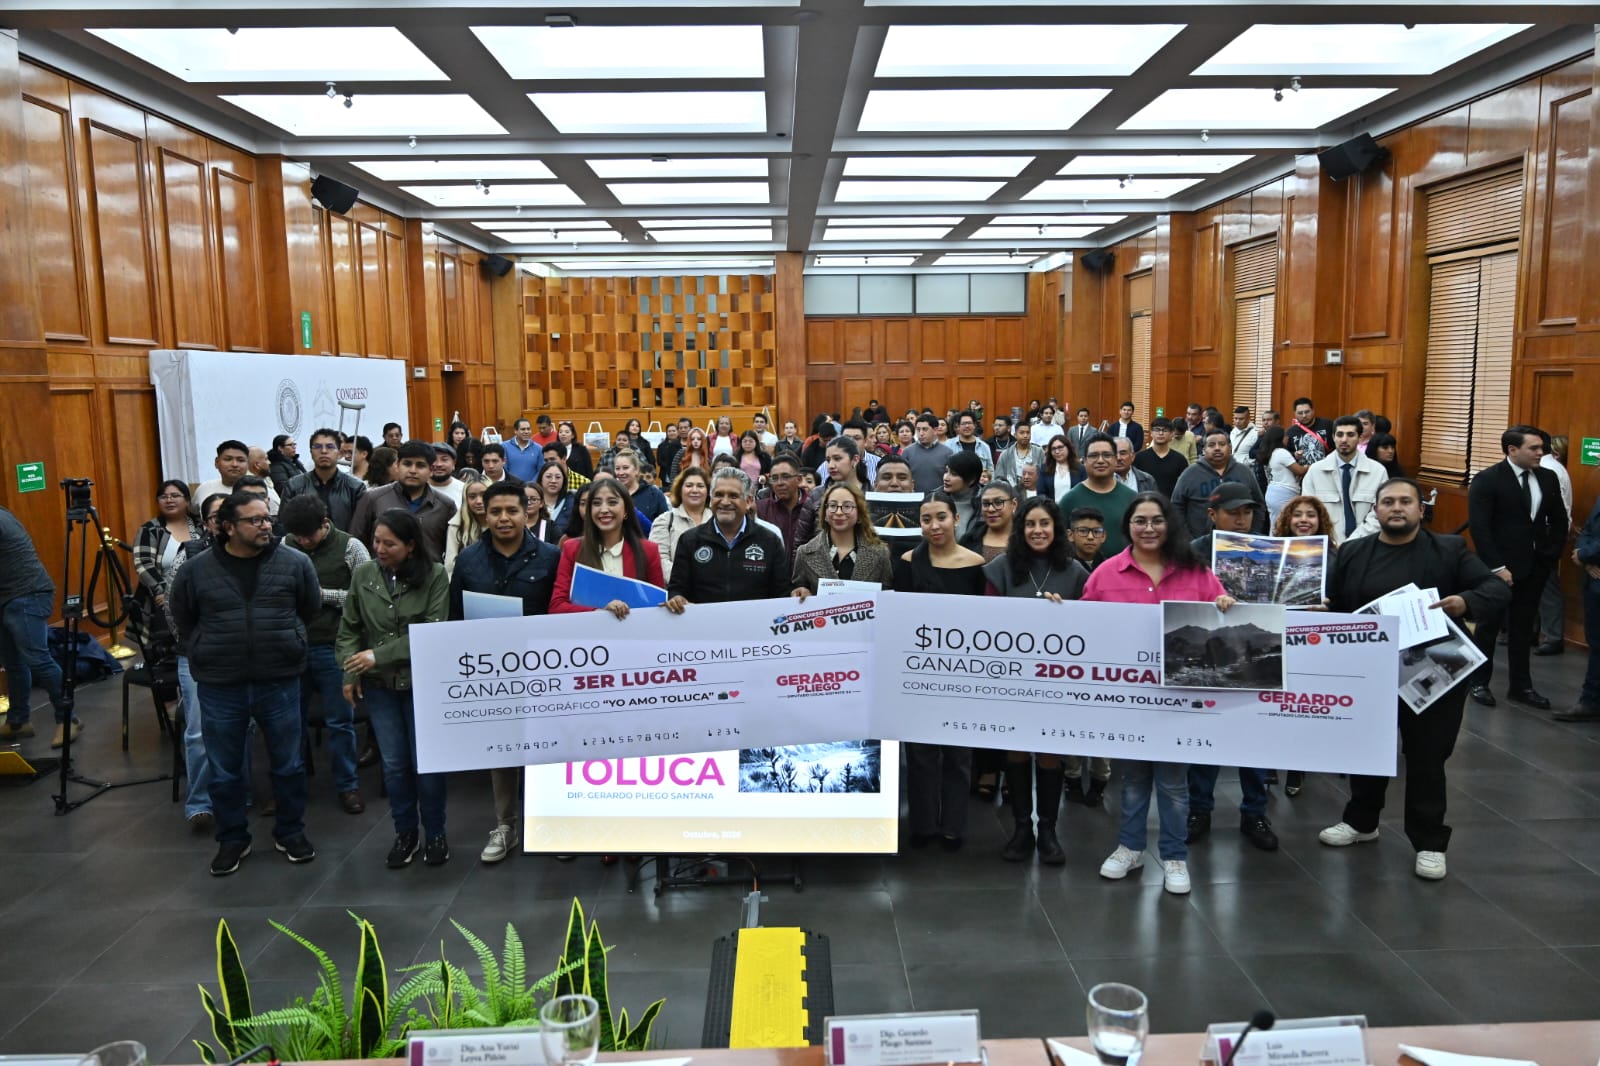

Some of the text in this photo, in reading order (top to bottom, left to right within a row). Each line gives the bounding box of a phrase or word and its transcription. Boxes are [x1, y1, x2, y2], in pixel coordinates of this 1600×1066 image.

[336, 387, 368, 400] CONGRESO
[770, 624, 789, 636] YO
[830, 610, 876, 626] TOLUC
[788, 611, 825, 621] CONCURSO
[1286, 626, 1320, 634] ONCURSO
[1327, 631, 1389, 644] TOLUCA
[914, 624, 1086, 656] $10,000.00
[458, 645, 610, 679] $5,000.00
[656, 644, 792, 664] CINCO MIL PESOS
[1137, 650, 1161, 663] DIE
[906, 655, 1022, 678] GANAD@R
[1034, 663, 1084, 680] 2DO
[447, 668, 697, 700] GANAD@R 3ER LUGAR
[776, 670, 860, 687] GERARDO
[796, 682, 841, 694] PLIEGO
[902, 680, 972, 694] CONCURSO
[975, 685, 1064, 700] FOTOGRÁFICO
[1094, 693, 1126, 703] AMO
[1258, 691, 1354, 707] GERARDO
[444, 706, 512, 720] CONCURSO
[515, 700, 600, 714] FOTOGRÁFICO
[628, 696, 658, 706] AMO
[1280, 704, 1330, 714] PLIEGO
[566, 757, 726, 786] TOLUCA
[568, 792, 714, 800] DIP. GERARDO PLIEGO SANTANA
